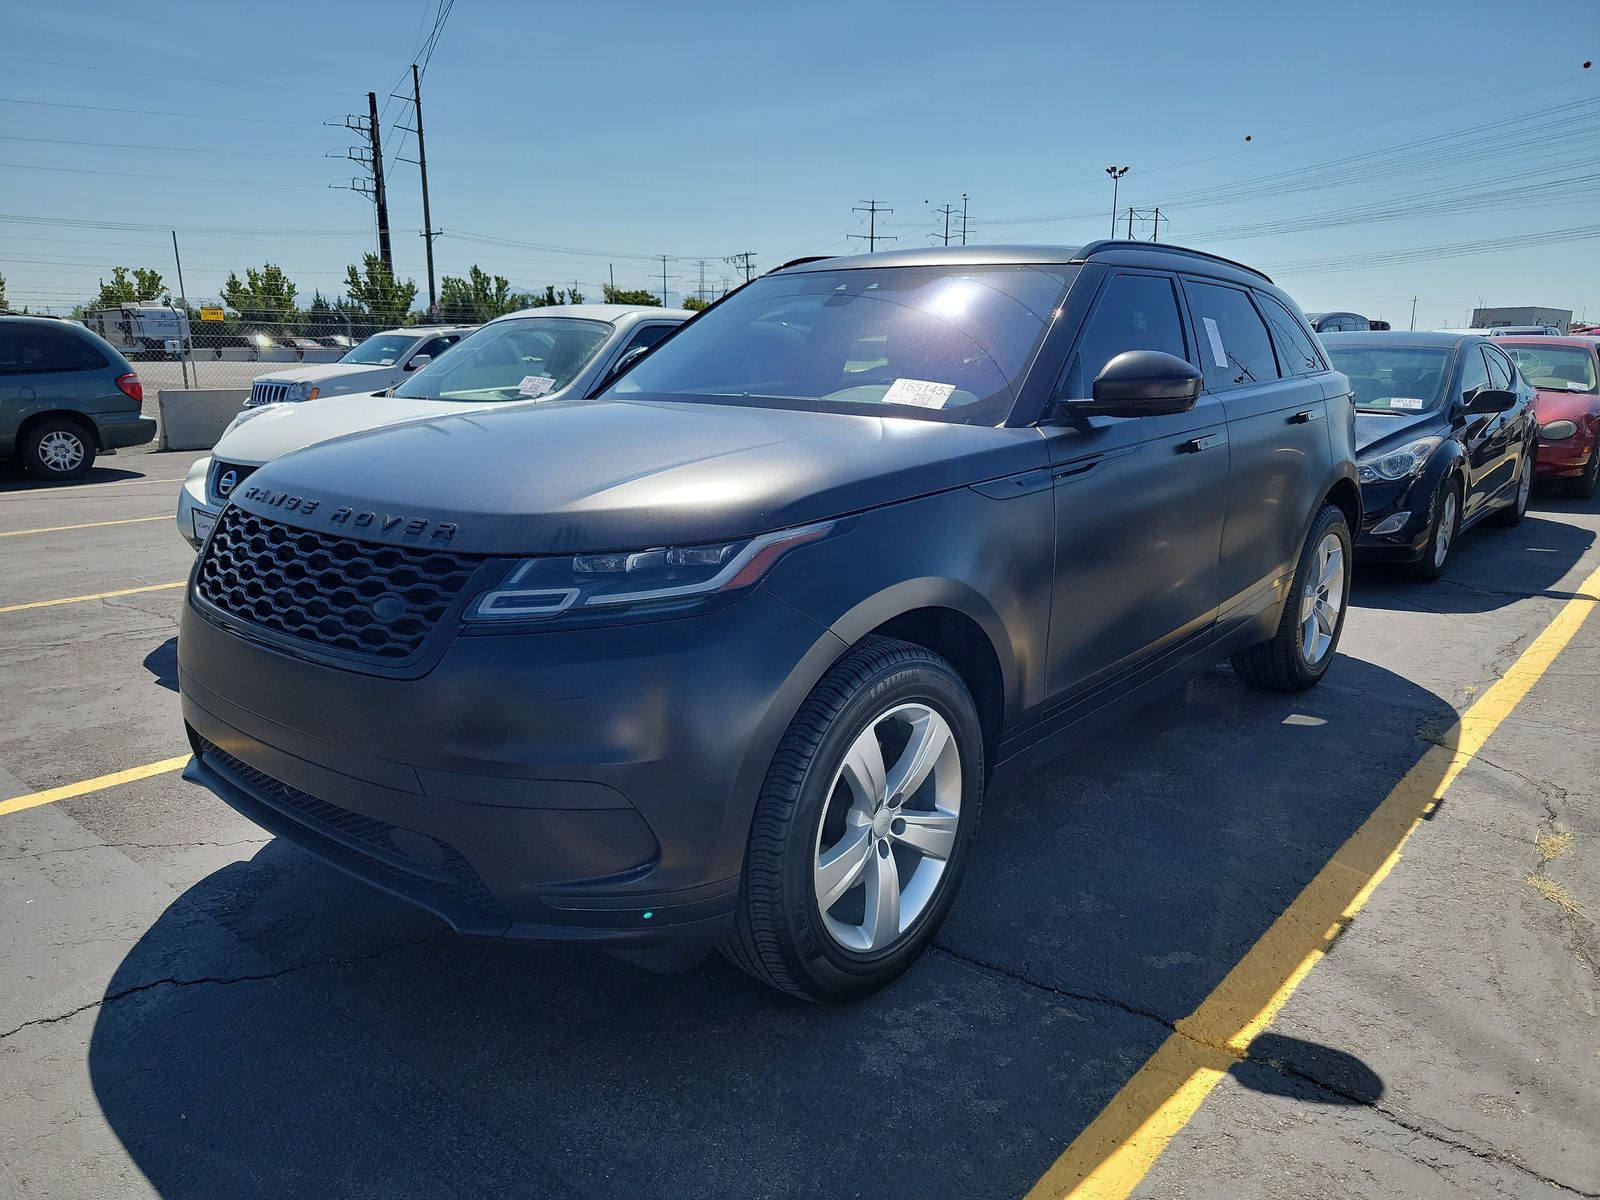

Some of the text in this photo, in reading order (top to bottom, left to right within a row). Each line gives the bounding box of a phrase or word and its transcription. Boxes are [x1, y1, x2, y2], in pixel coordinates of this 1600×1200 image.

[900, 382, 953, 397] 1651453
[244, 487, 457, 540] RANGE ROVER
